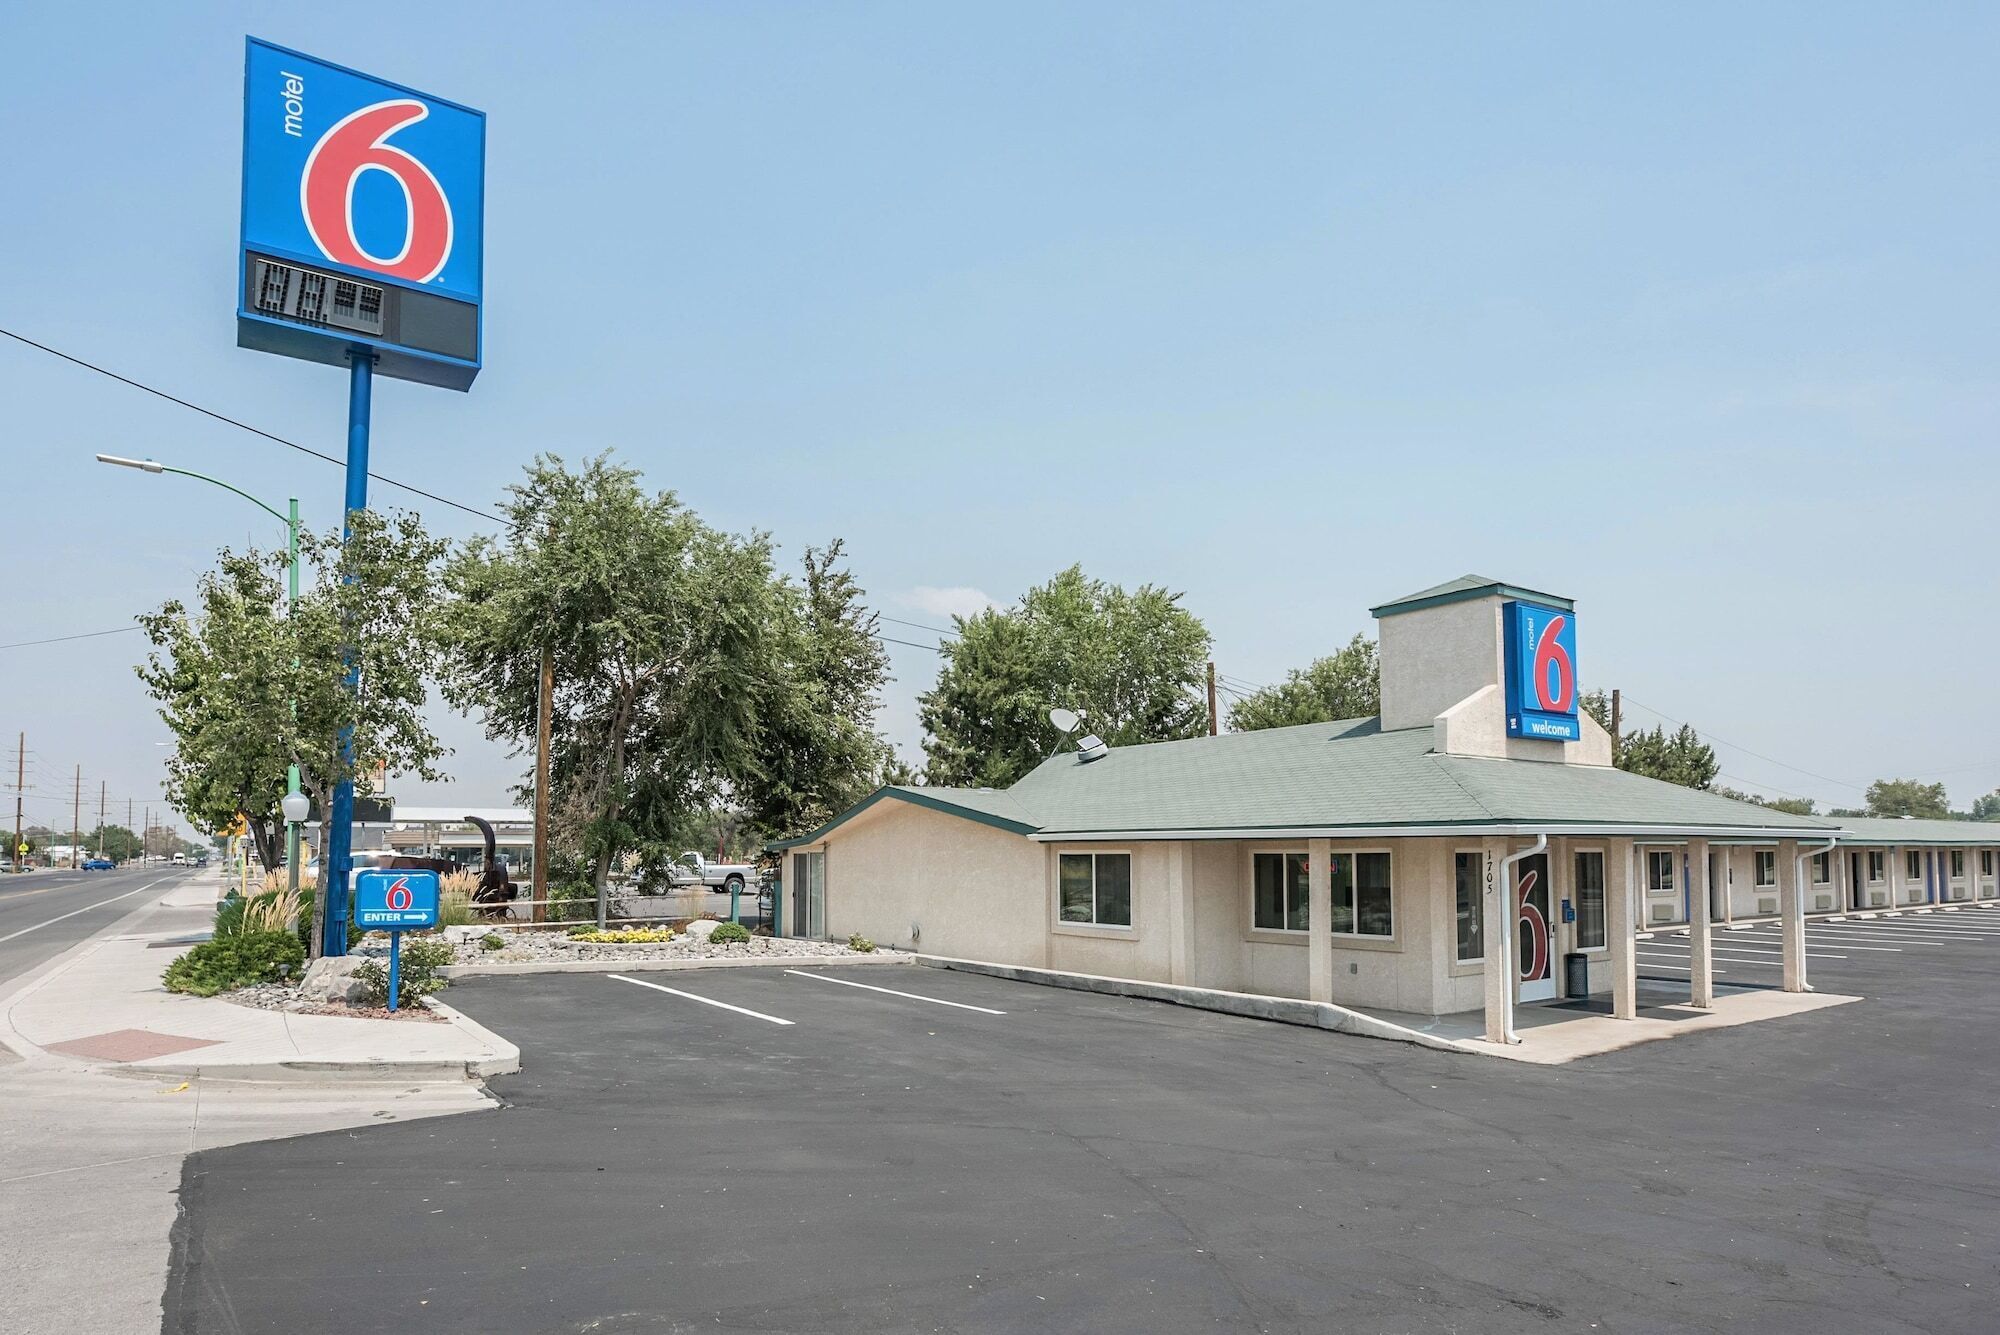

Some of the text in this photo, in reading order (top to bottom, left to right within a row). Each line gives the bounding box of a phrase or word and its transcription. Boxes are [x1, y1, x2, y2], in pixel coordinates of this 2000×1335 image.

[280, 70, 304, 138] motel
[300, 98, 454, 284] 6
[1533, 615, 1574, 713] 6
[1531, 720, 1571, 737] welcome
[364, 913, 401, 922] ENTER
[385, 876, 413, 911] 6
